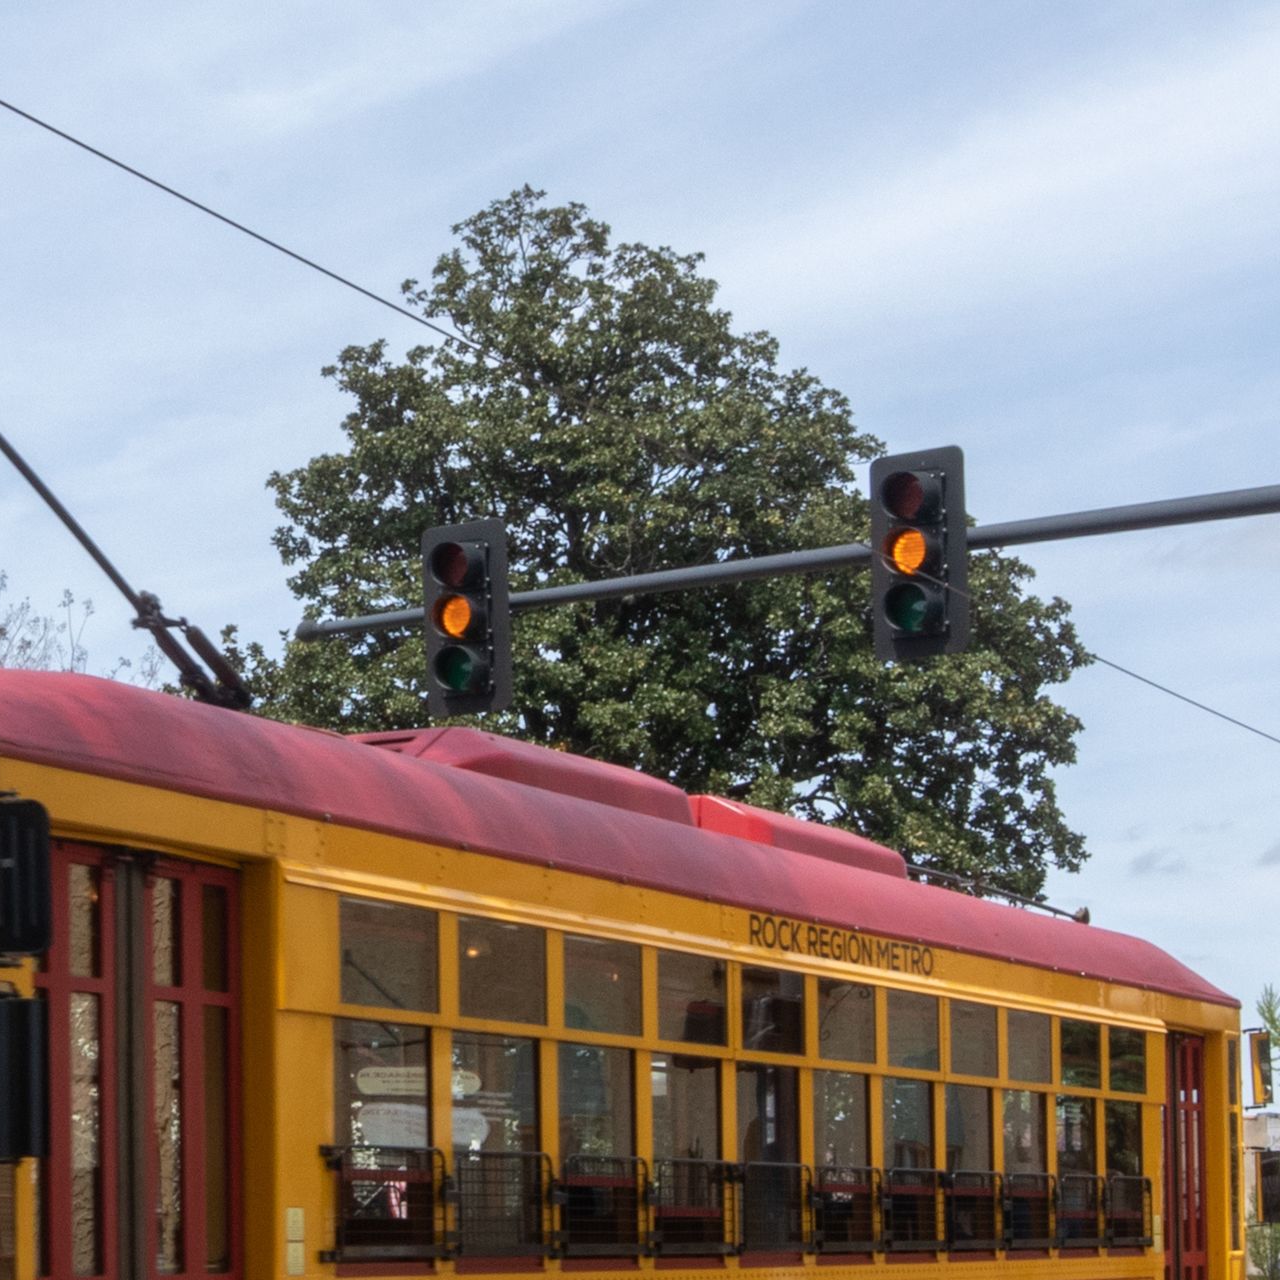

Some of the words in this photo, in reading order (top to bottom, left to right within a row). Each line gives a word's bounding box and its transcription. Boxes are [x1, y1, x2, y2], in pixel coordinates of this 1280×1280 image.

[749, 913, 802, 955] ROCK
[807, 924, 872, 967] REGION
[876, 938, 935, 977] METRO
